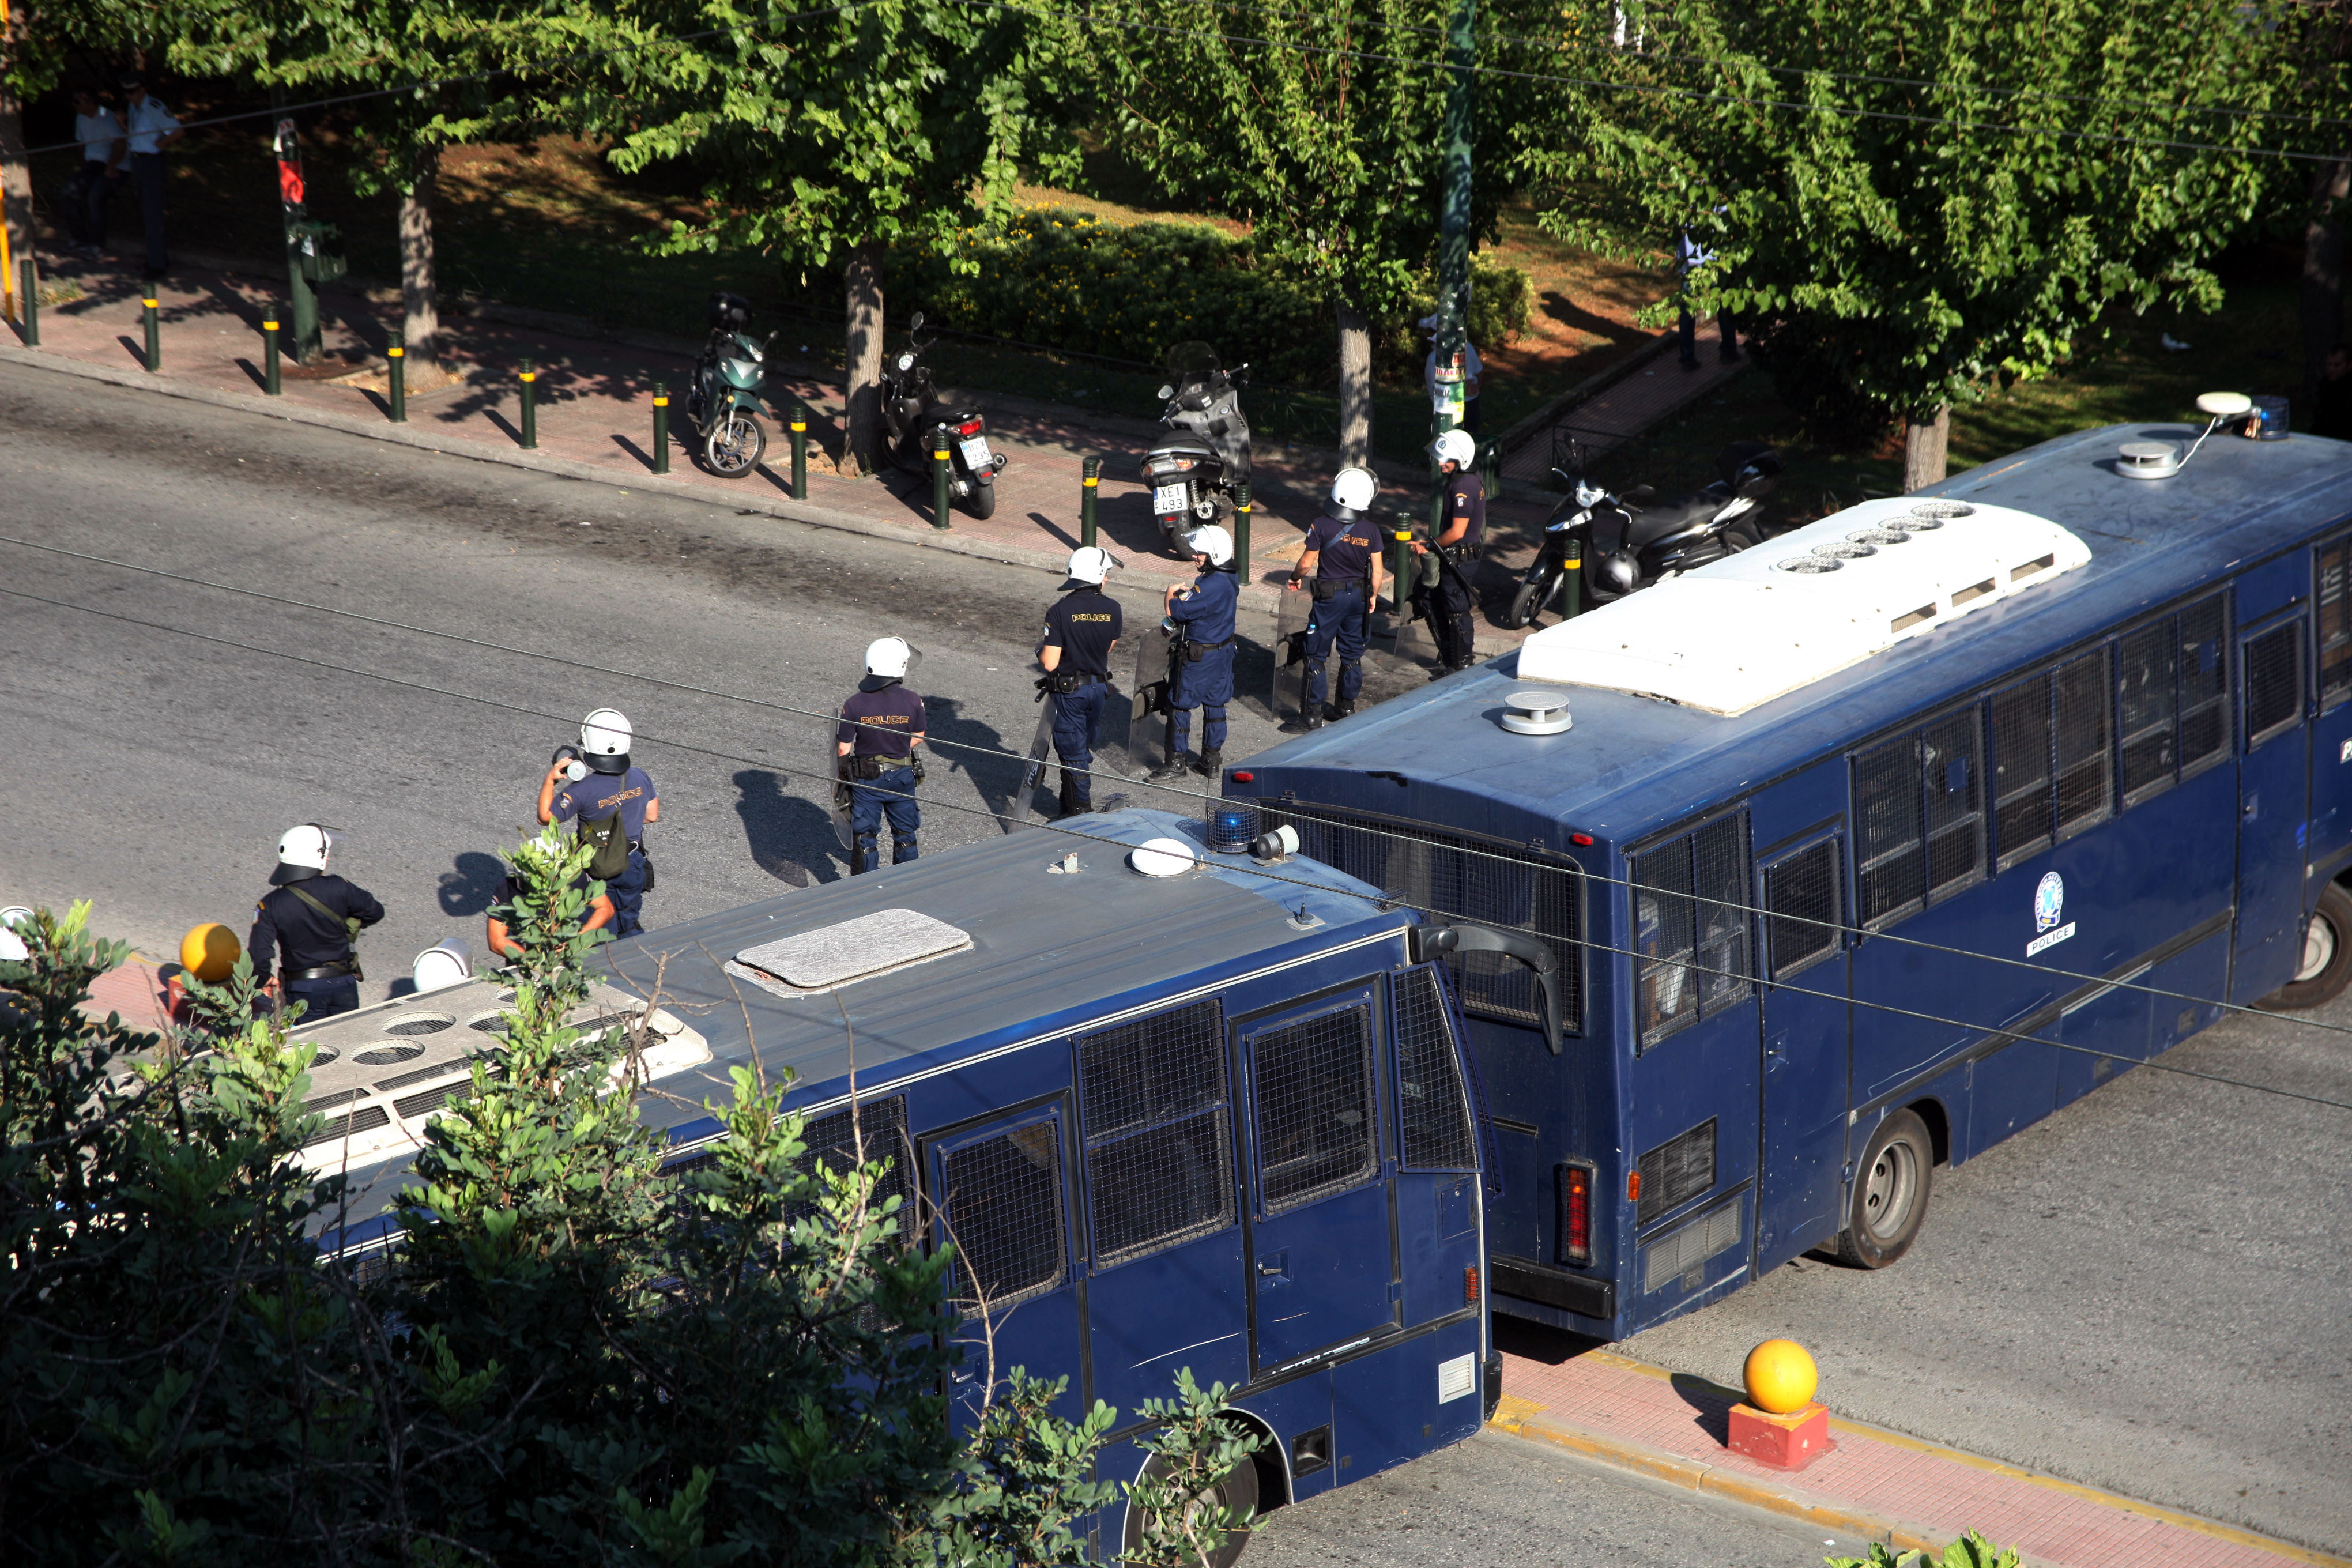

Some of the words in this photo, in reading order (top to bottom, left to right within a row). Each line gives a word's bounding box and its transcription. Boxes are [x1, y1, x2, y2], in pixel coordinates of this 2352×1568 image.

[973, 450, 990, 461] 235
[1162, 499, 1182, 510] 493
[1072, 613, 1111, 623] POLICE
[860, 715, 909, 725] POLICE
[2031, 927, 2070, 952] POLICE
